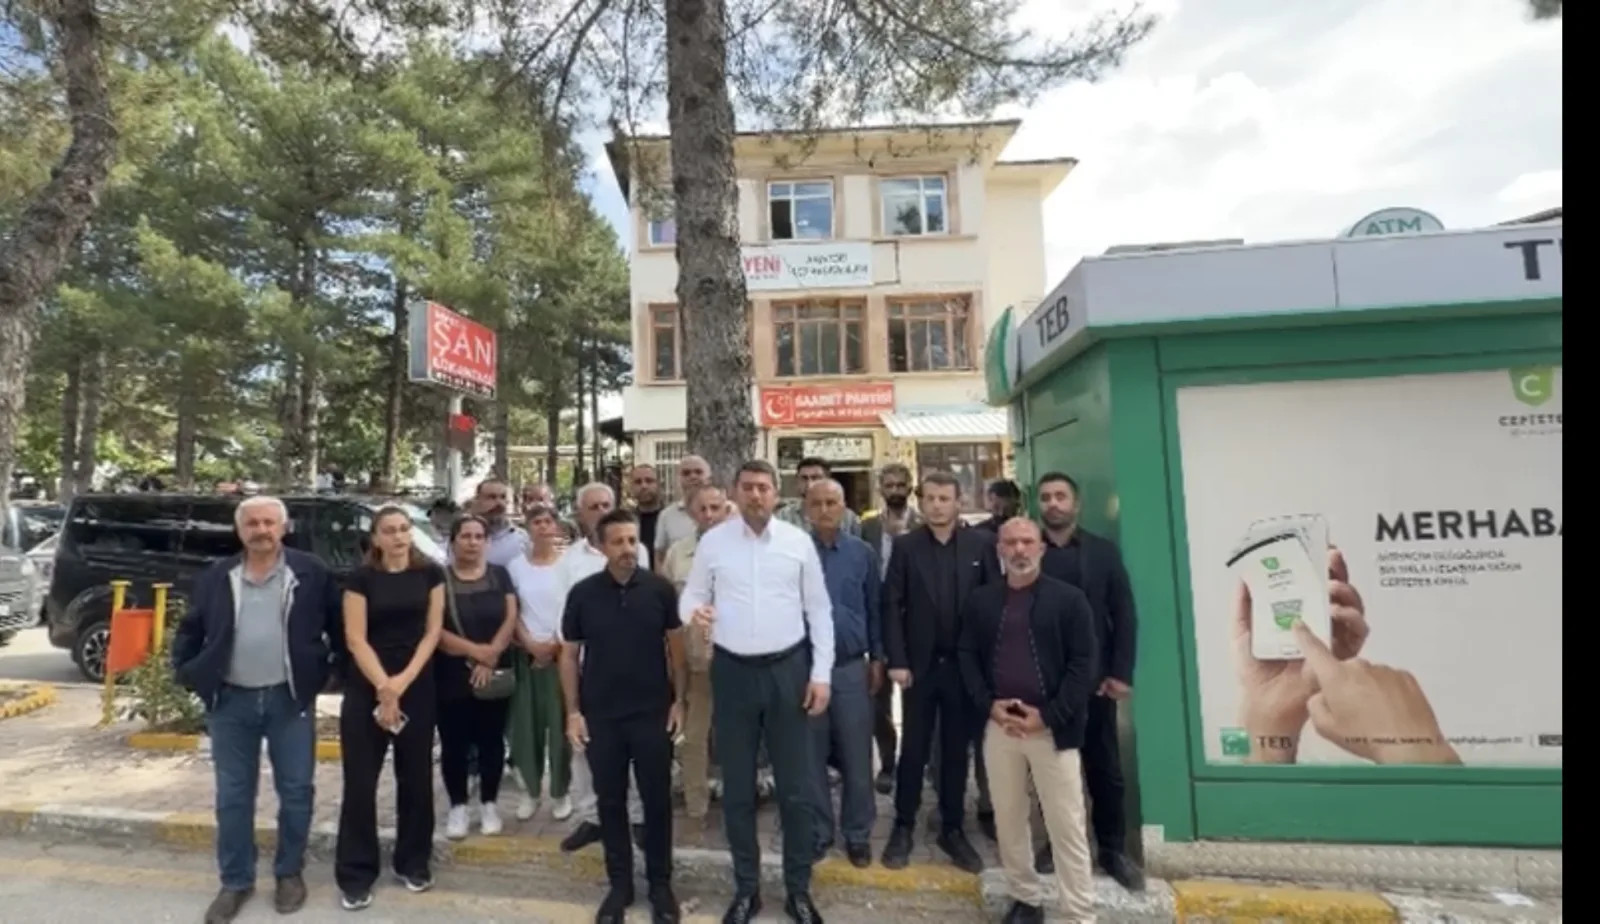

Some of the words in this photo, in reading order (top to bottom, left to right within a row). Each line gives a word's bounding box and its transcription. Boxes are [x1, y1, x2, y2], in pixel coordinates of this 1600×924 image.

[1366, 216, 1421, 235] ATM
[1503, 238, 1562, 280] T
[1036, 295, 1069, 348] TEB
[433, 319, 492, 367] ŞAN
[1375, 508, 1562, 542] MERHAB
[1256, 735, 1292, 749] TEB
